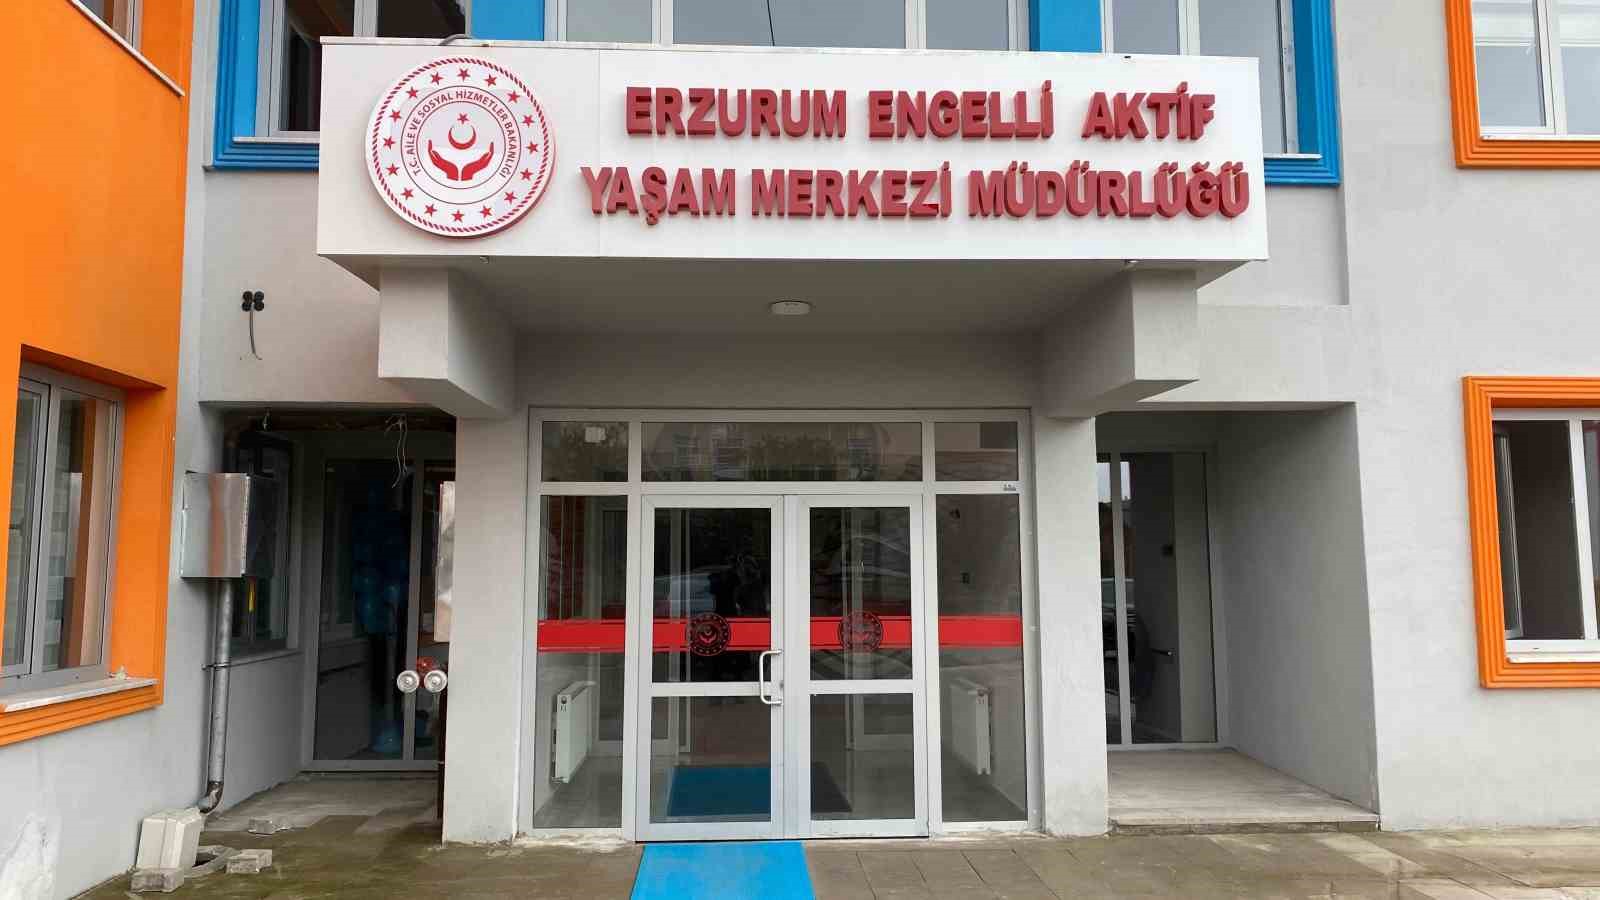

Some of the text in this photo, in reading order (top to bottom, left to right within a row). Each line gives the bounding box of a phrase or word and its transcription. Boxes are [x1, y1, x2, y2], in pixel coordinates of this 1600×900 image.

[417, 92, 454, 118] SOSYAL
[455, 90, 508, 121] HİZMETLER
[626, 80, 1216, 141] ERZURUM ENGELLİ AKTİF
[409, 118, 421, 131] VE
[405, 133, 416, 155] AİLE
[500, 121, 517, 178] BAKANLIĞI
[580, 160, 1250, 225] YAŞAM MERKEZİ MÜDÜRLÜĞÜ
